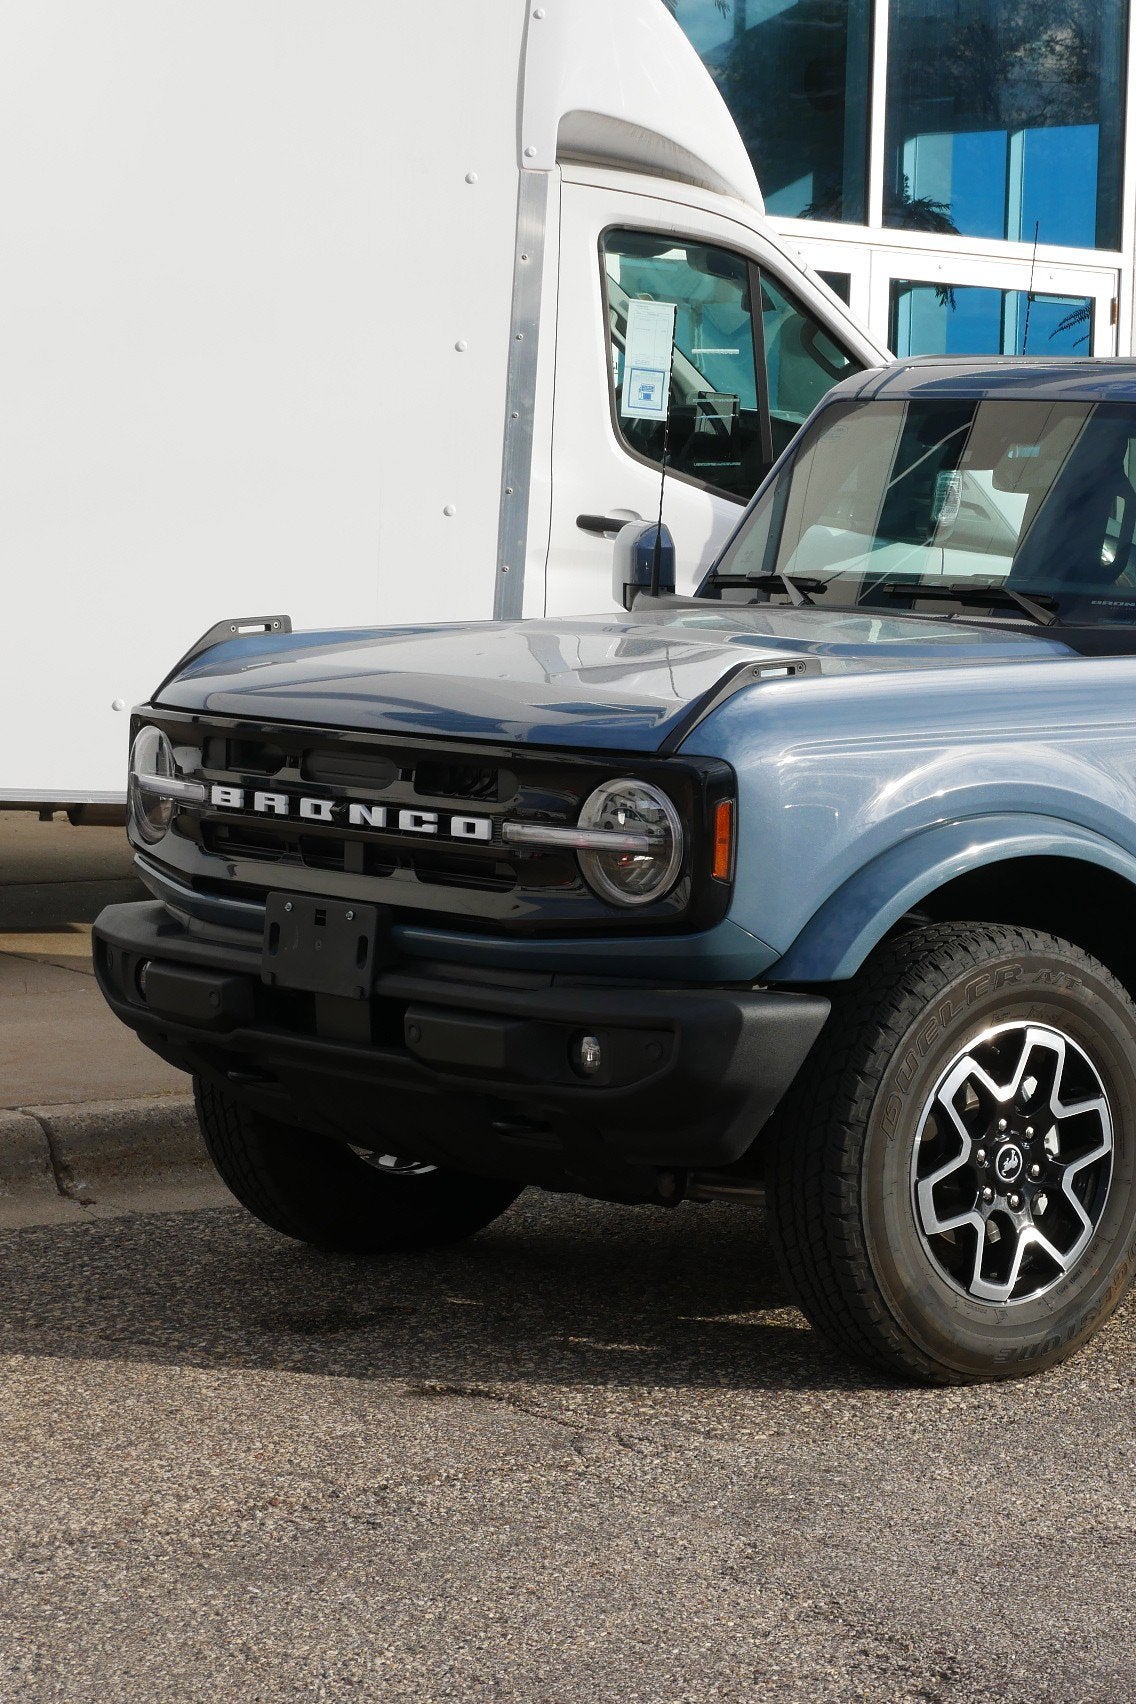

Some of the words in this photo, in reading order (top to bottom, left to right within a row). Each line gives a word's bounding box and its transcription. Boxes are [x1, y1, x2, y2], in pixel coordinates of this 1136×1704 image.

[210, 785, 493, 841] BRONCO
[879, 963, 1024, 1142] DUELER
[1031, 968, 1083, 990] A/T
